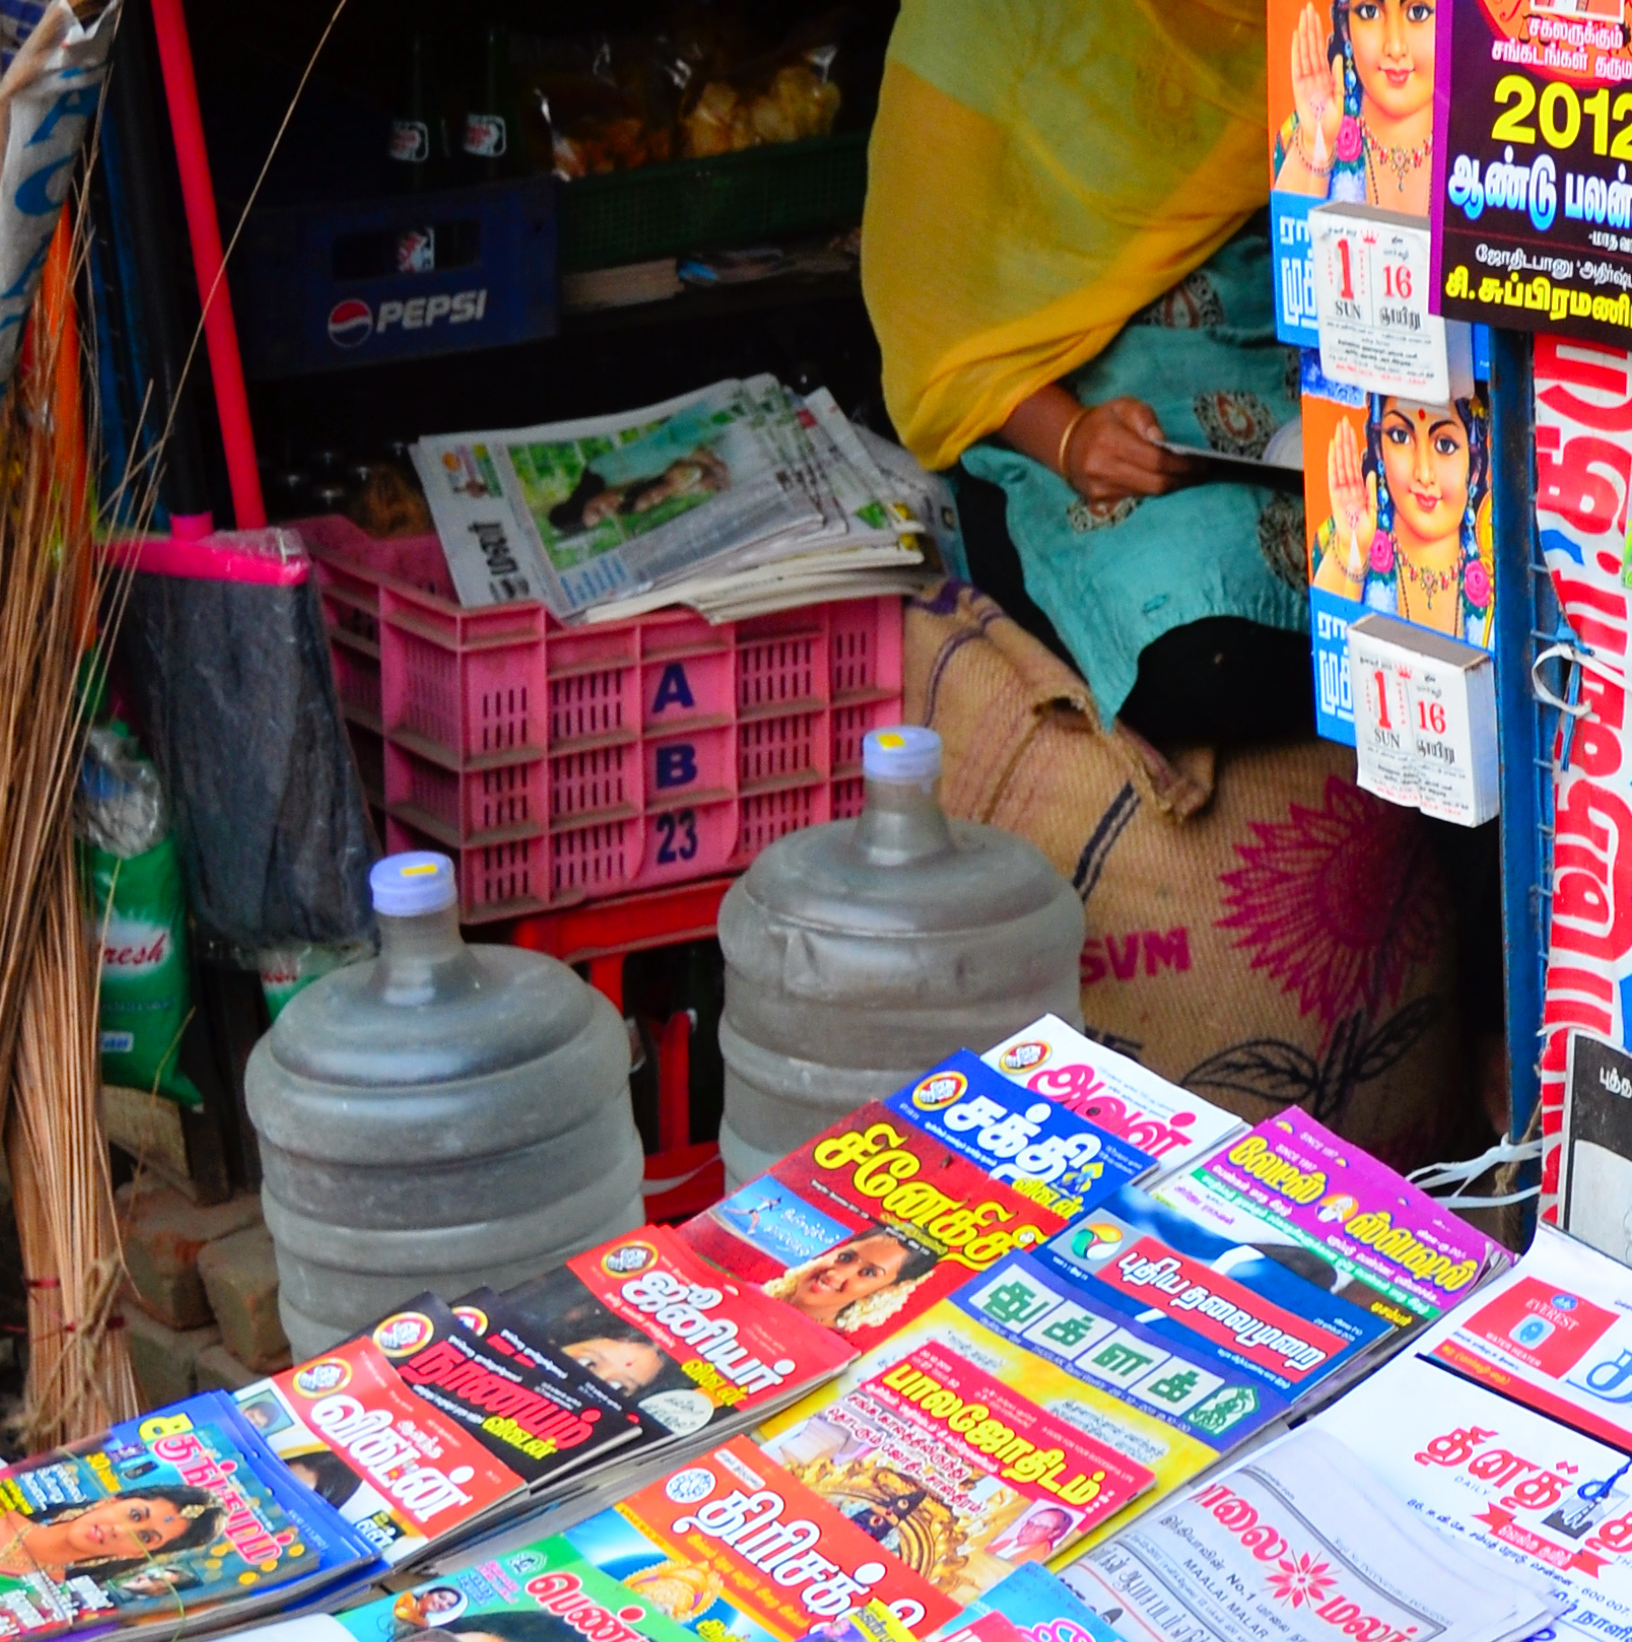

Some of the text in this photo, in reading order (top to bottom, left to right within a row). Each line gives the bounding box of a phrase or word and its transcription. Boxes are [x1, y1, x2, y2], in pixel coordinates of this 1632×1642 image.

[1448, 148, 1557, 232] ஆண்டு
[1336, 240, 1355, 301] 1
[1382, 264, 1413, 297] 16
[376, 289, 488, 335] PEPSI
[1335, 300, 1363, 320] SUN
[652, 664, 695, 712] A
[1374, 671, 1393, 729] 1
[1418, 700, 1447, 734] 16
[655, 743, 698, 788] B
[1374, 727, 1401, 748] SUN
[655, 810, 698, 864] 23
[943, 1094, 1102, 1189] சக்தி
[812, 1121, 1050, 1271] சினேகிதி
[1230, 1133, 1479, 1293] லேடீஸ் ஸ்பெஷல்
[621, 1269, 798, 1394] ஜூனியர்
[982, 1276, 1201, 1408] துக்ளக்
[1117, 1250, 1327, 1372] புதிய தலைமுறை
[401, 1343, 602, 1451] நாணயம்
[680, 1358, 750, 1407] விகடன்
[311, 1394, 476, 1524] விகடன்
[483, 1413, 558, 1460] விகடன்
[881, 1363, 1103, 1505] பாலஜோதிடம்
[1415, 1423, 1580, 1515] தினத்
[1183, 1558, 1271, 1641] MAALAI MALAR
